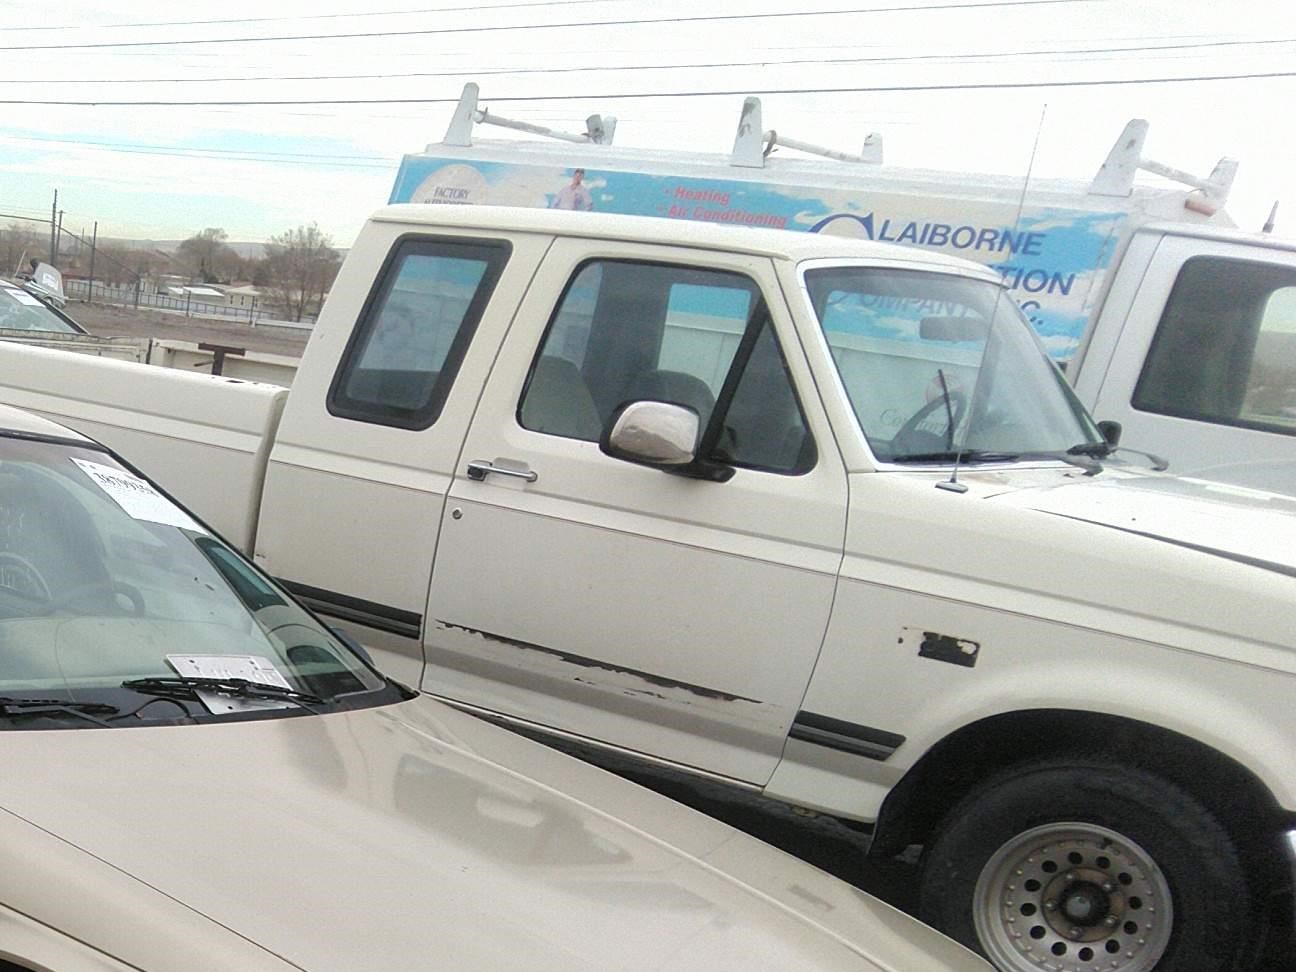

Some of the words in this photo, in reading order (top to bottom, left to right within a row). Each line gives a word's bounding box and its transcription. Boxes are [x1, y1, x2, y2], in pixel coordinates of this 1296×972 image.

[433, 186, 471, 199] FACTORY
[673, 187, 731, 206] Heating
[692, 206, 789, 230] Conditioning
[988, 264, 1076, 296] TION
